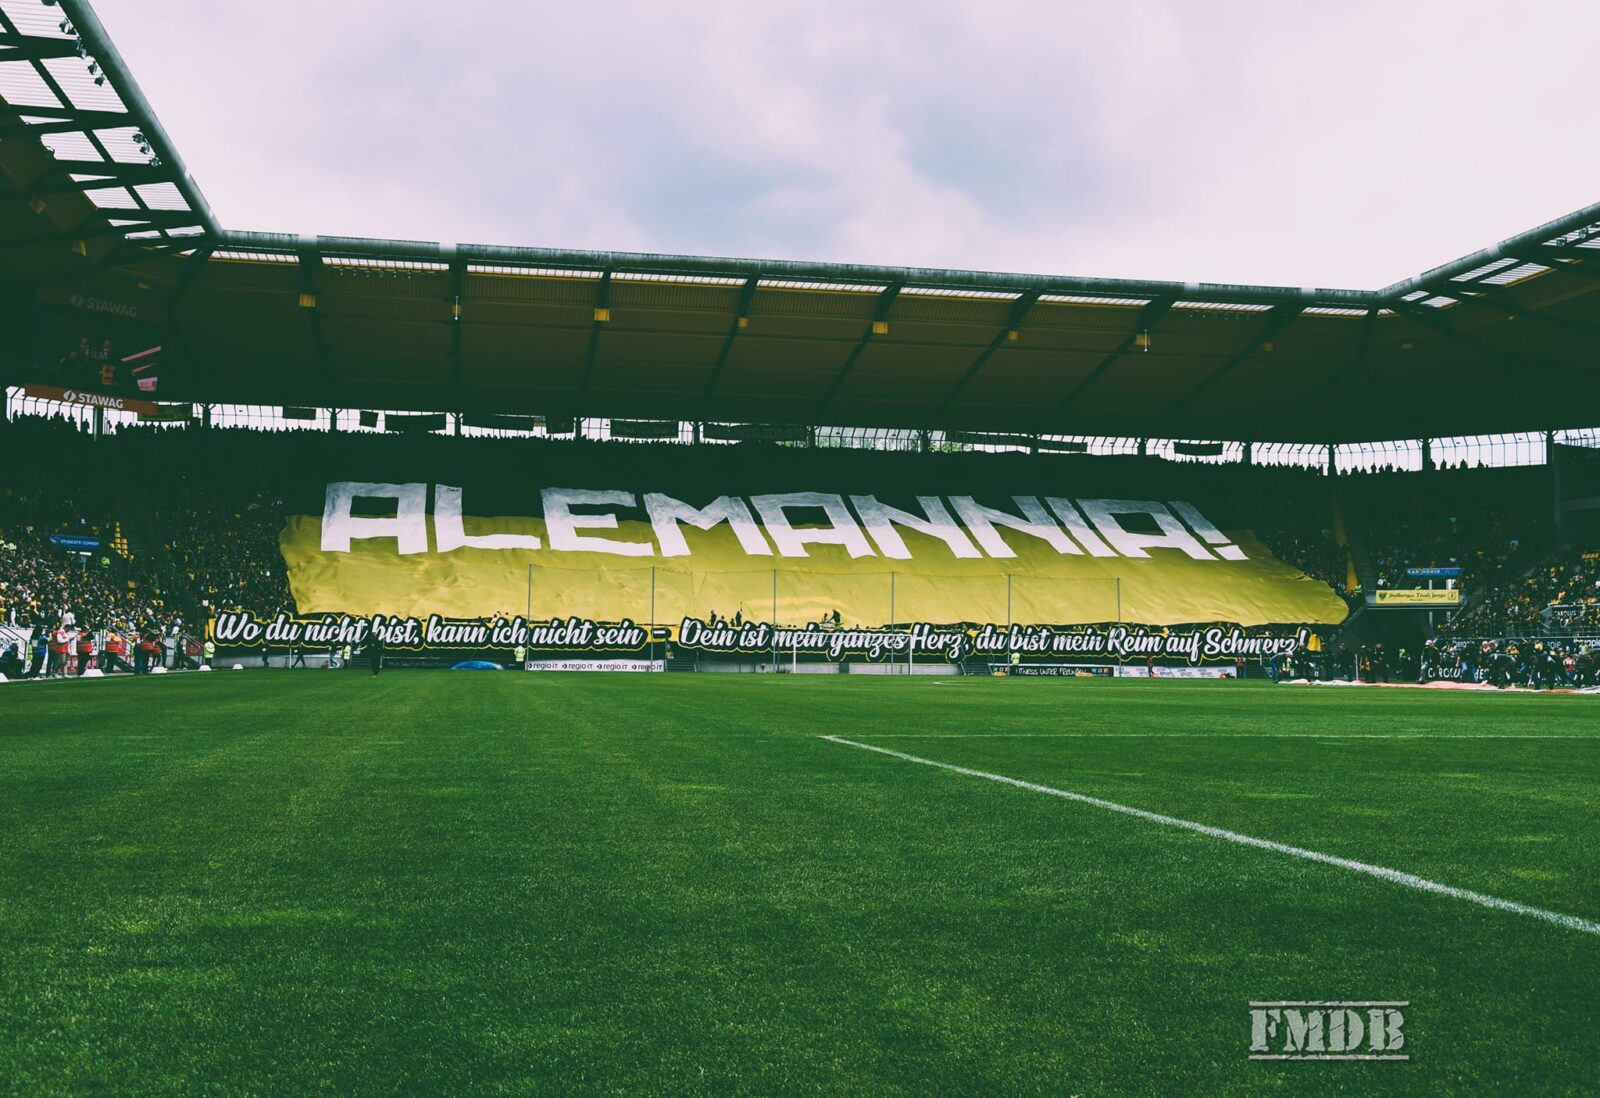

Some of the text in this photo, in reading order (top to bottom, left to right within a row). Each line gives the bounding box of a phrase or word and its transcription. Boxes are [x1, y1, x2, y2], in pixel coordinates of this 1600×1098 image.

[86, 297, 138, 318] STAWAG
[78, 393, 124, 410] STAWAG
[320, 481, 1249, 562] ALEMANNIA!
[217, 613, 262, 640] Wo
[265, 614, 302, 641] du
[304, 615, 367, 643] nicht
[371, 614, 419, 645] bist,
[426, 616, 488, 644] kann
[492, 615, 529, 643] ich
[532, 616, 593, 644] nicht
[595, 619, 642, 645] sein
[680, 618, 735, 646] Dein
[740, 623, 769, 647] ist
[774, 622, 824, 647] mein
[829, 630, 907, 658] ganzes
[911, 622, 970, 659] Herz,
[976, 625, 1007, 651] du
[1010, 625, 1049, 652] bist
[1053, 626, 1106, 652] mein
[1107, 626, 1164, 656] Reim
[1166, 626, 1203, 662] auf
[1204, 625, 1307, 657] Schmerz!
